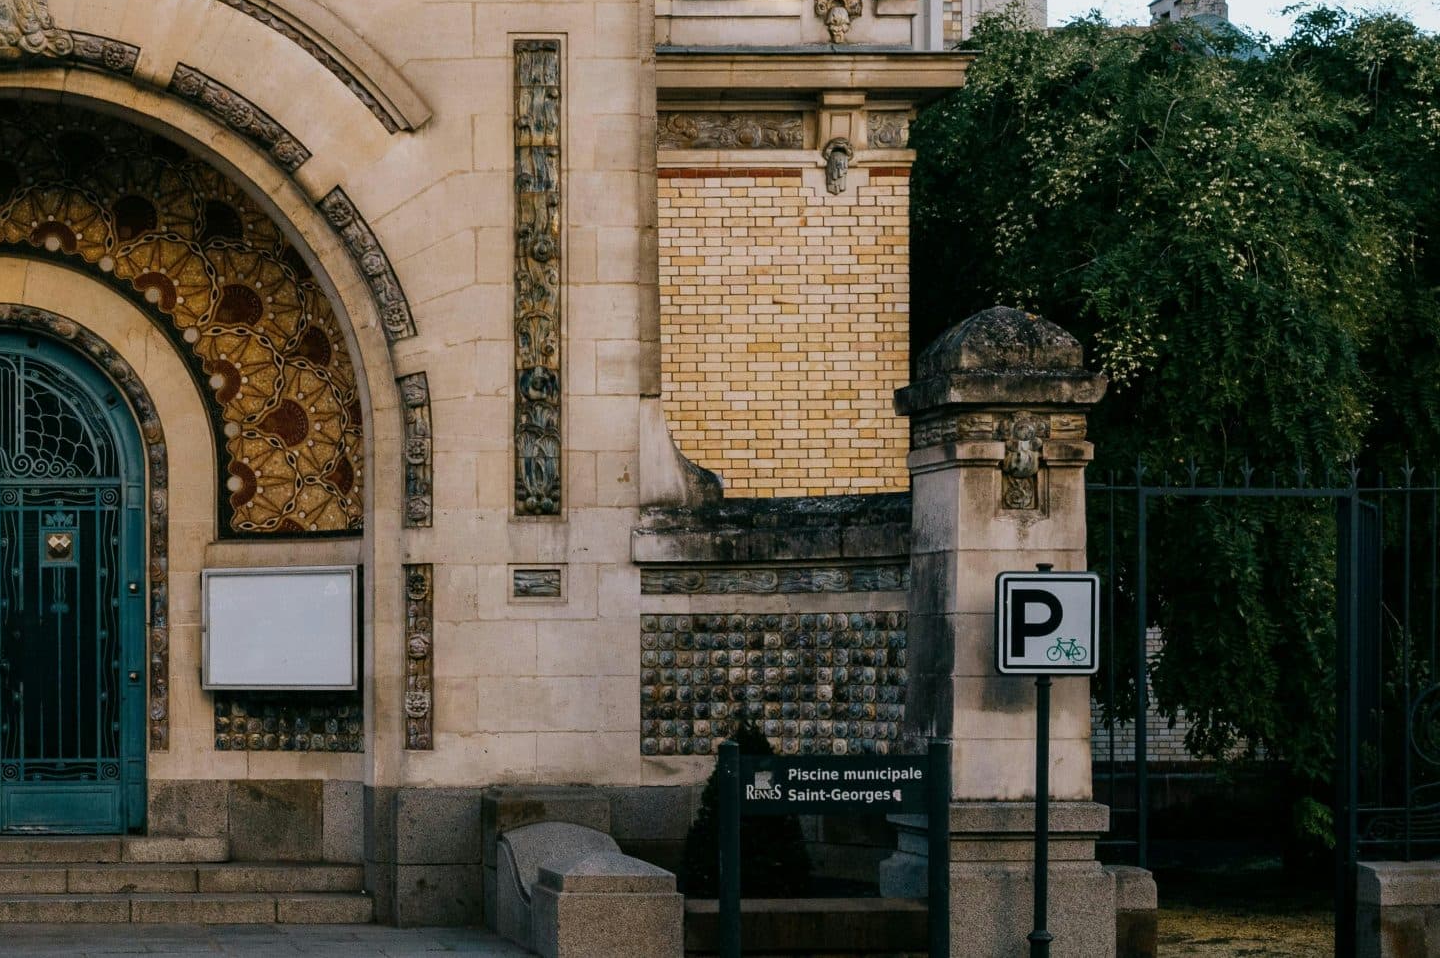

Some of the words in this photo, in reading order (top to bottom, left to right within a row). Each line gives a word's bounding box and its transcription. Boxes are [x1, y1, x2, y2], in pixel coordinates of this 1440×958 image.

[1010, 589, 1063, 658] P
[788, 768, 839, 781] Piscine
[844, 767, 923, 783] municipale
[788, 788, 891, 804] Saint-Georges
